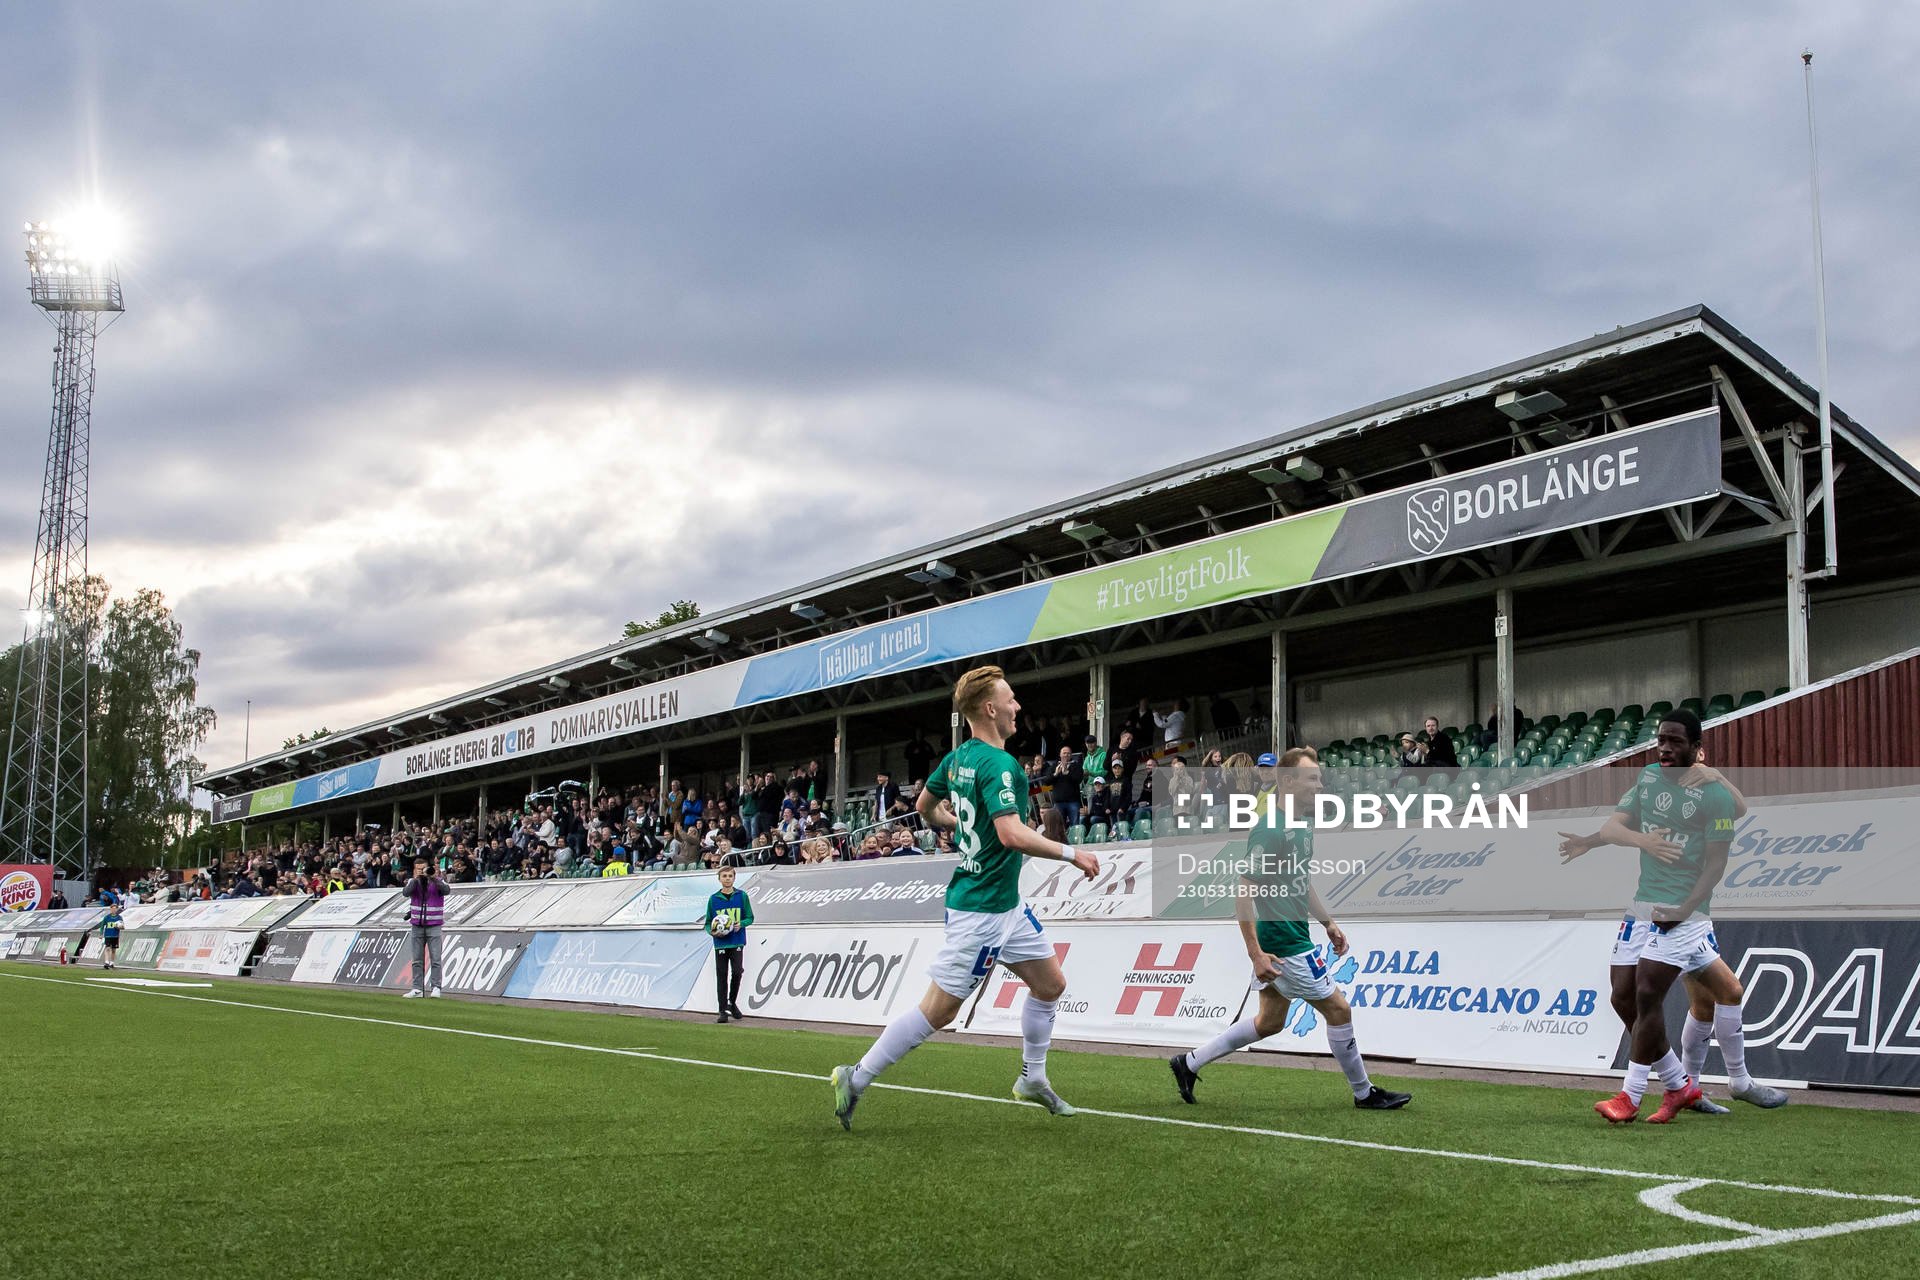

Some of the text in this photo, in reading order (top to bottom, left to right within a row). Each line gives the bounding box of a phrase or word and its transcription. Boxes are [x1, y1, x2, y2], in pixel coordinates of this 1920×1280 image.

[1454, 446, 1639, 526] BORLÄNGE
[1096, 546, 1252, 612] #TrevligtFolk
[826, 624, 922, 682] Hållbar Arena
[551, 690, 679, 744] DOMNARVSVALLEN
[406, 726, 535, 775] BORLÄNGE ENERGI arena
[1729, 822, 1877, 858] Svensk
[1386, 839, 1496, 872] Svensk
[1, 880, 35, 897] BURGER
[1377, 872, 1465, 898] Cater
[1724, 860, 1843, 889] Cater
[1, 888, 36, 907] KING
[757, 879, 946, 907] Volkswagen Borlänge
[353, 931, 402, 958] norling
[346, 956, 382, 984] skylt
[748, 940, 903, 1010] granitor
[1361, 950, 1440, 976] DALA
[1123, 972, 1196, 985] HENNINGSONS
[1055, 1000, 1089, 1014] STALCO
[1178, 1005, 1227, 1018] INSTALCO
[1350, 984, 1598, 1017] KYLMECANO AB
[1522, 1019, 1589, 1036] INSTALCO
